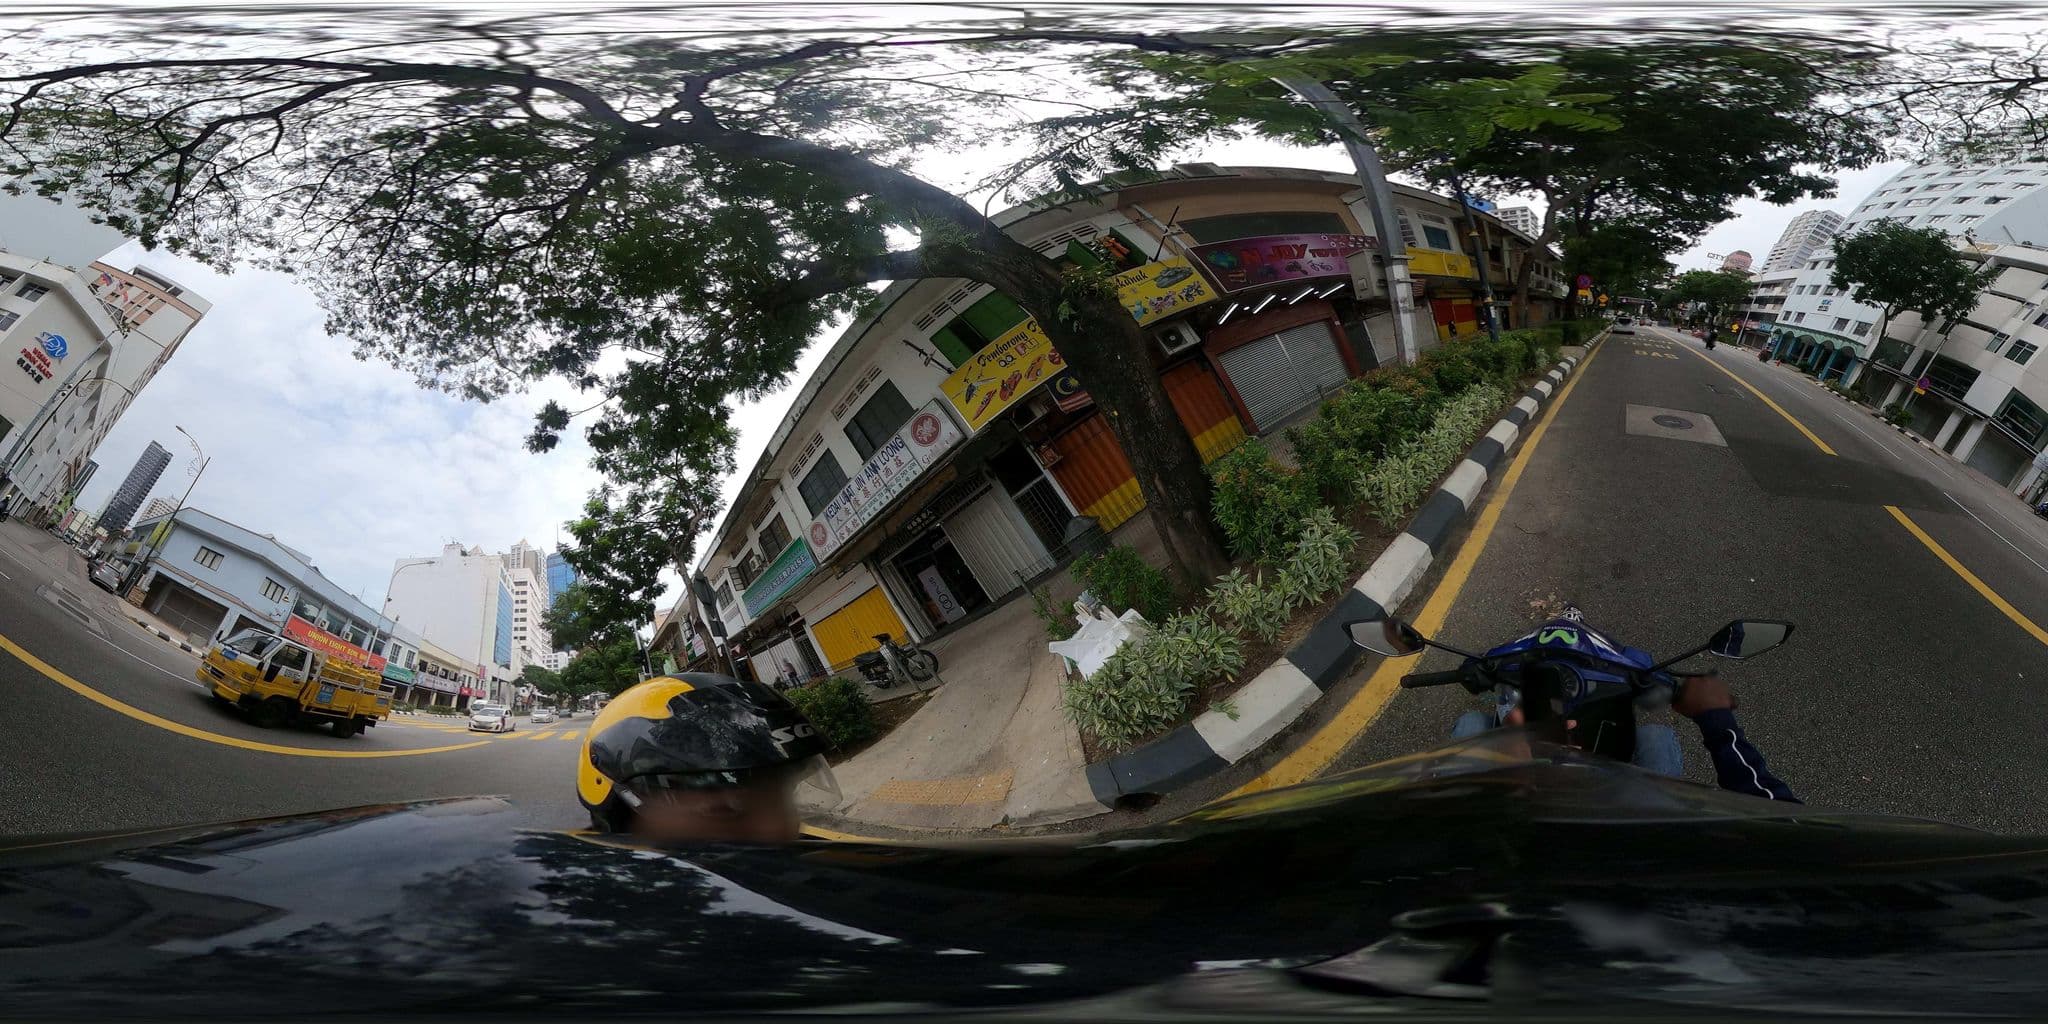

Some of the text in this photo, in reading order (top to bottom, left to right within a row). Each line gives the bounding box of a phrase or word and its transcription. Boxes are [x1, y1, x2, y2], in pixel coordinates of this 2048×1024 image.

[977, 331, 1028, 367] Pemborong
[824, 436, 905, 519] KEDAI UBAT JIN ANN LOONG
[307, 630, 328, 645] UNION
